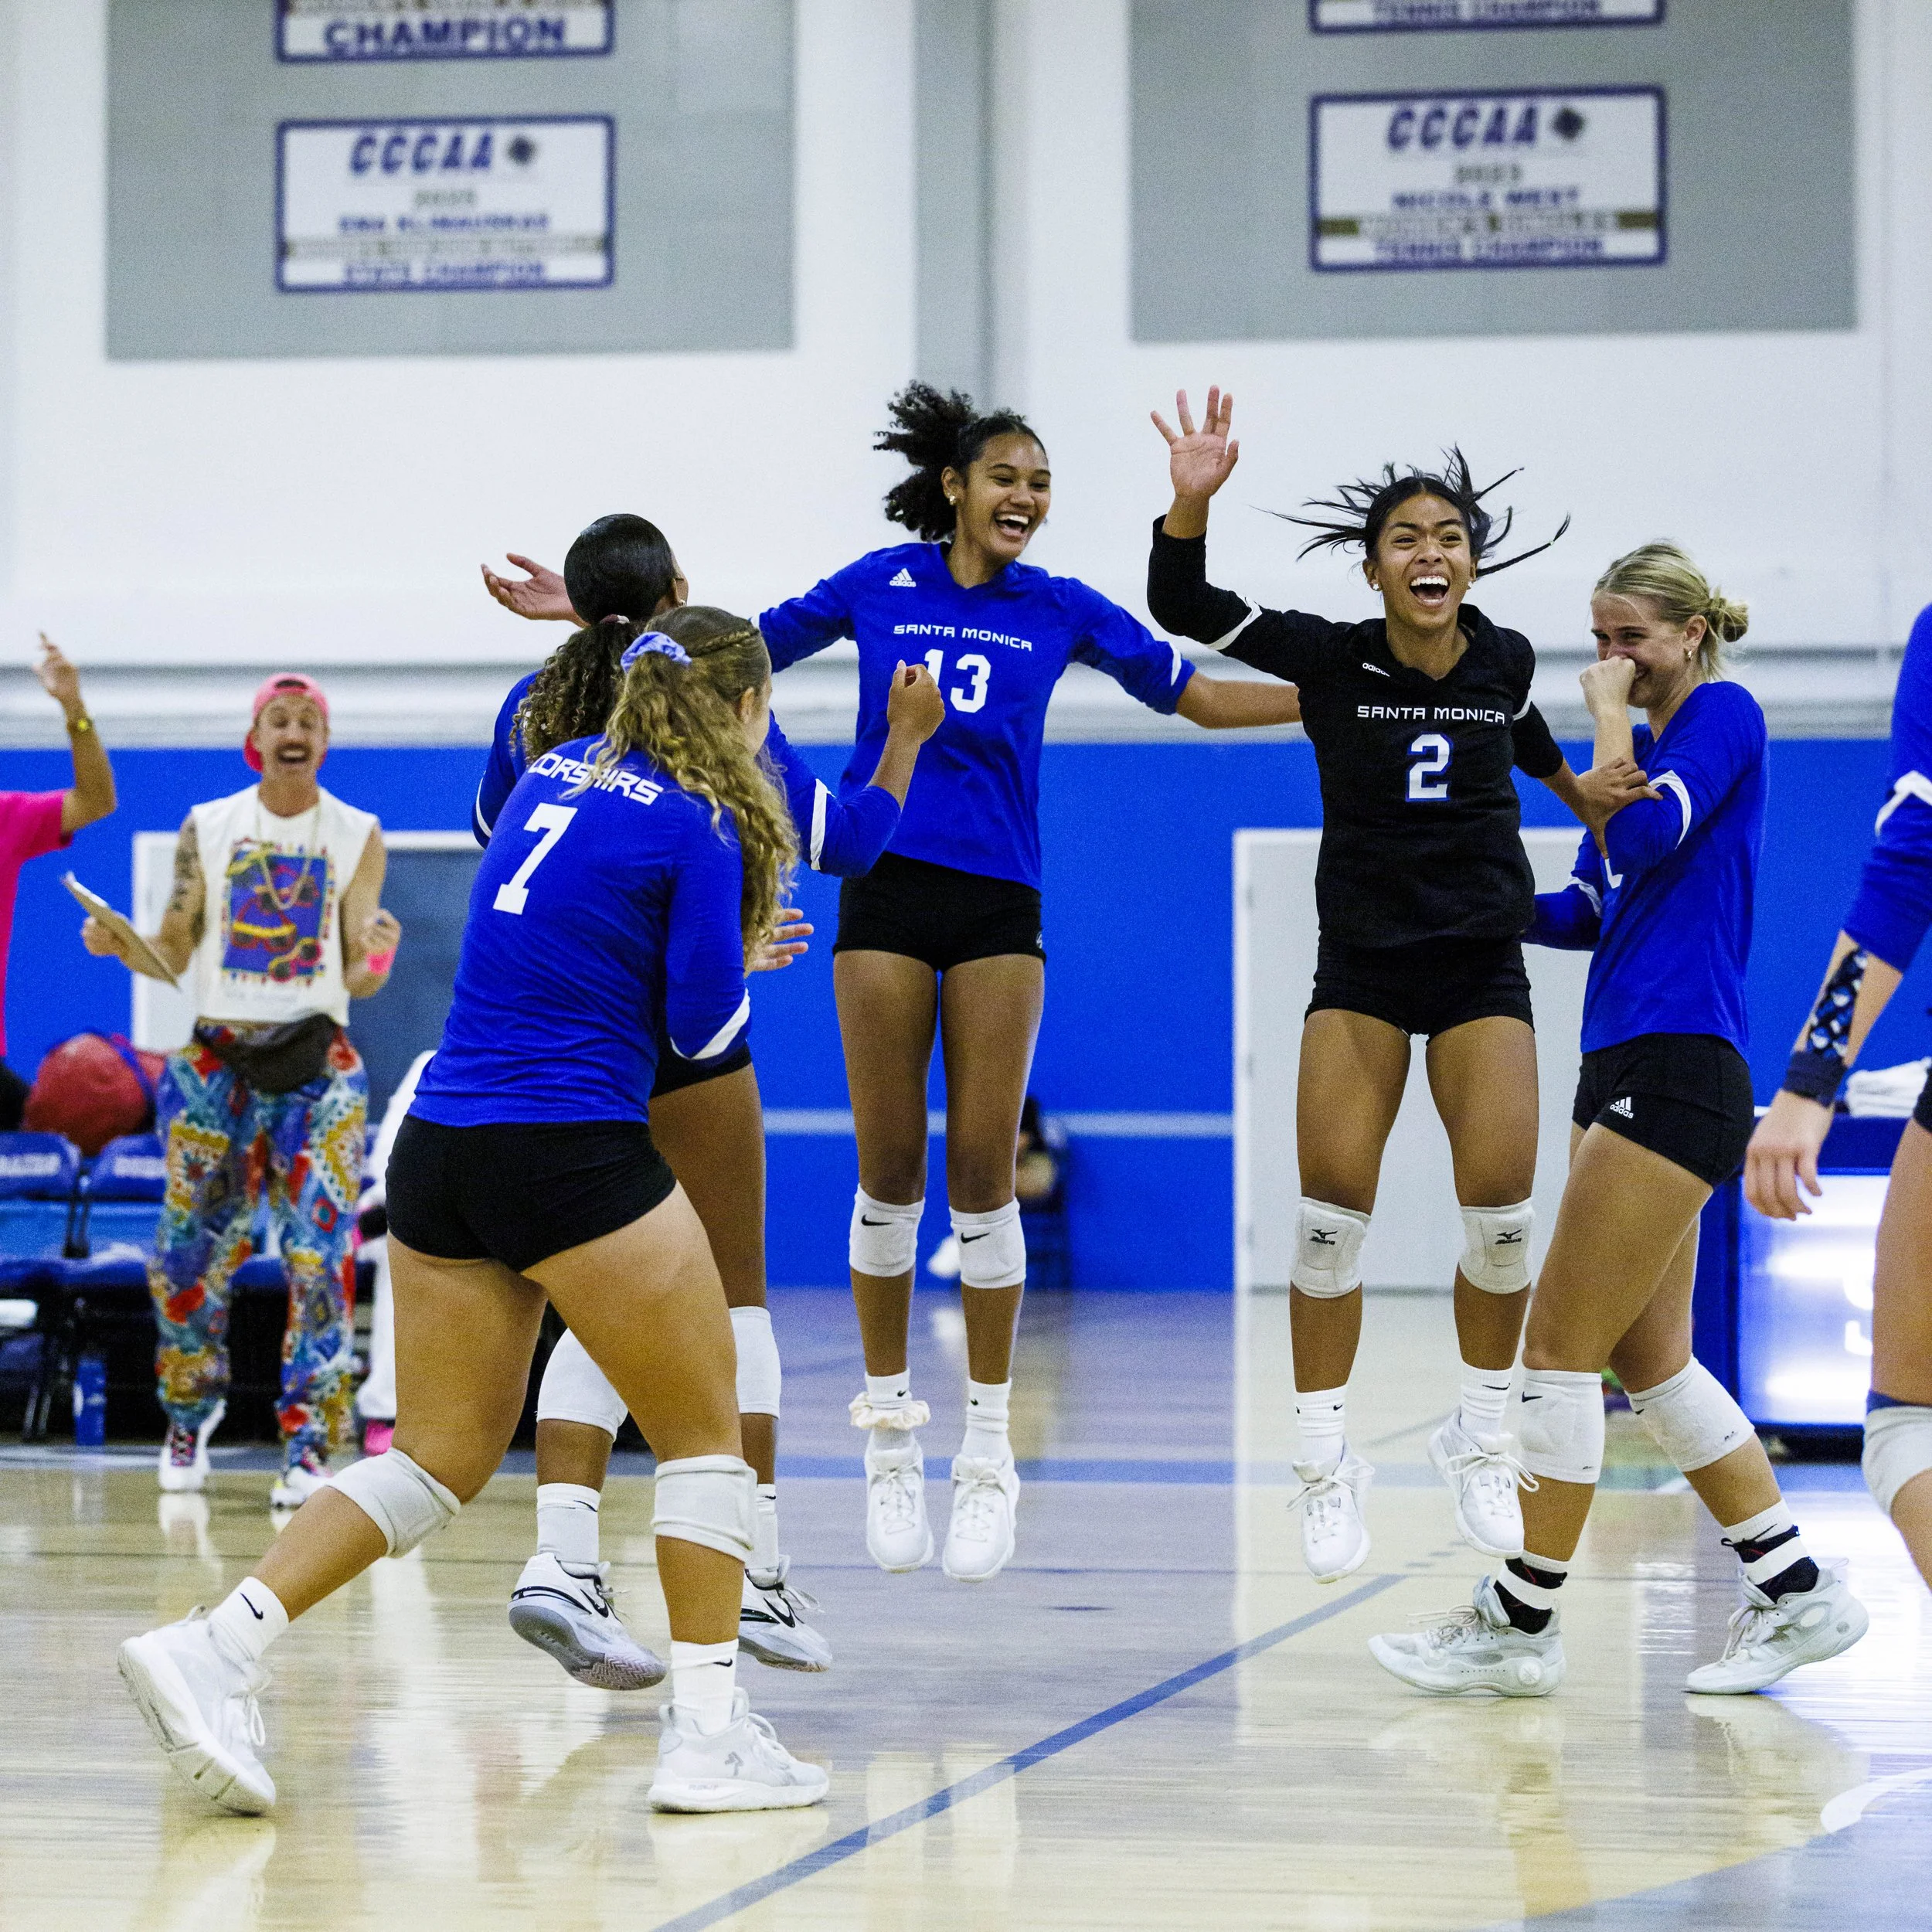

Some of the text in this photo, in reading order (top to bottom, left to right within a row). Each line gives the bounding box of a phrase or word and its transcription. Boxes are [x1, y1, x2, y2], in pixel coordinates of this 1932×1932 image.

[325, 15, 567, 53] CHAMPION
[1386, 106, 1538, 151] CCCAA
[350, 131, 493, 175] CCCAA
[893, 624, 1032, 651] SANTA MONICA
[923, 648, 992, 713] 13
[1357, 706, 1505, 725] SANTA MONICA
[1407, 733, 1452, 801] 2
[492, 802, 578, 915] 7
[1610, 1104, 1634, 1119] adidas
